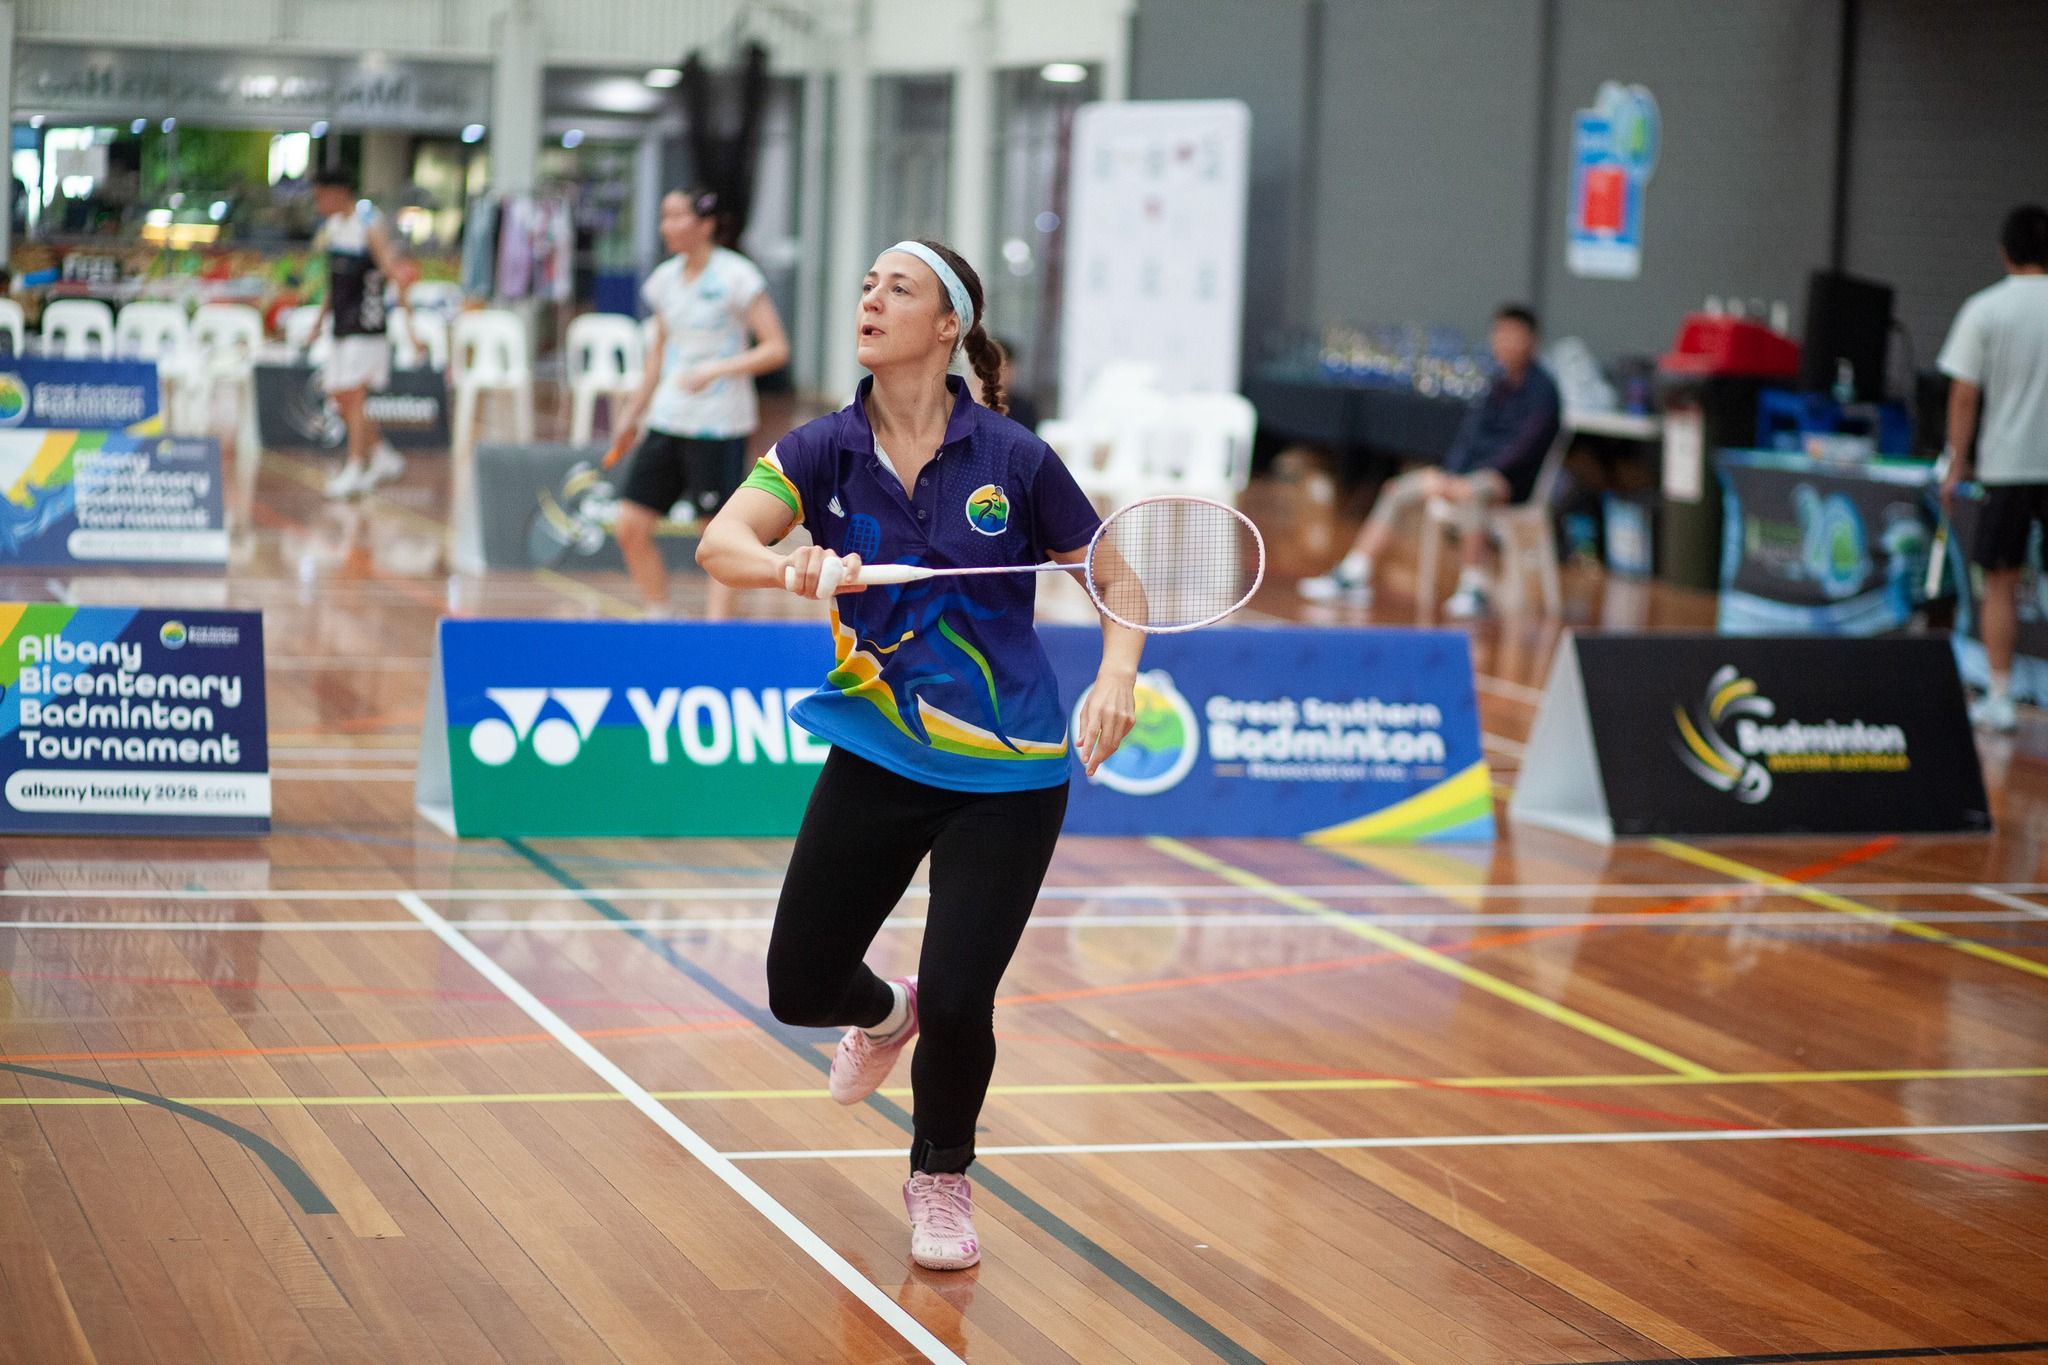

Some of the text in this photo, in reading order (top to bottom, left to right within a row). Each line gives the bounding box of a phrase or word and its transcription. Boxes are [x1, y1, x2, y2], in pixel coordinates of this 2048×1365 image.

[18, 633, 142, 672] Albany
[19, 664, 242, 707] Bicentenary
[20, 697, 214, 731] Badminton
[626, 686, 831, 764] YONE
[1205, 695, 1441, 729] Great Southern
[19, 730, 241, 764] Tournament
[1208, 719, 1445, 763] Badminton
[1736, 718, 1907, 755] Badminton
